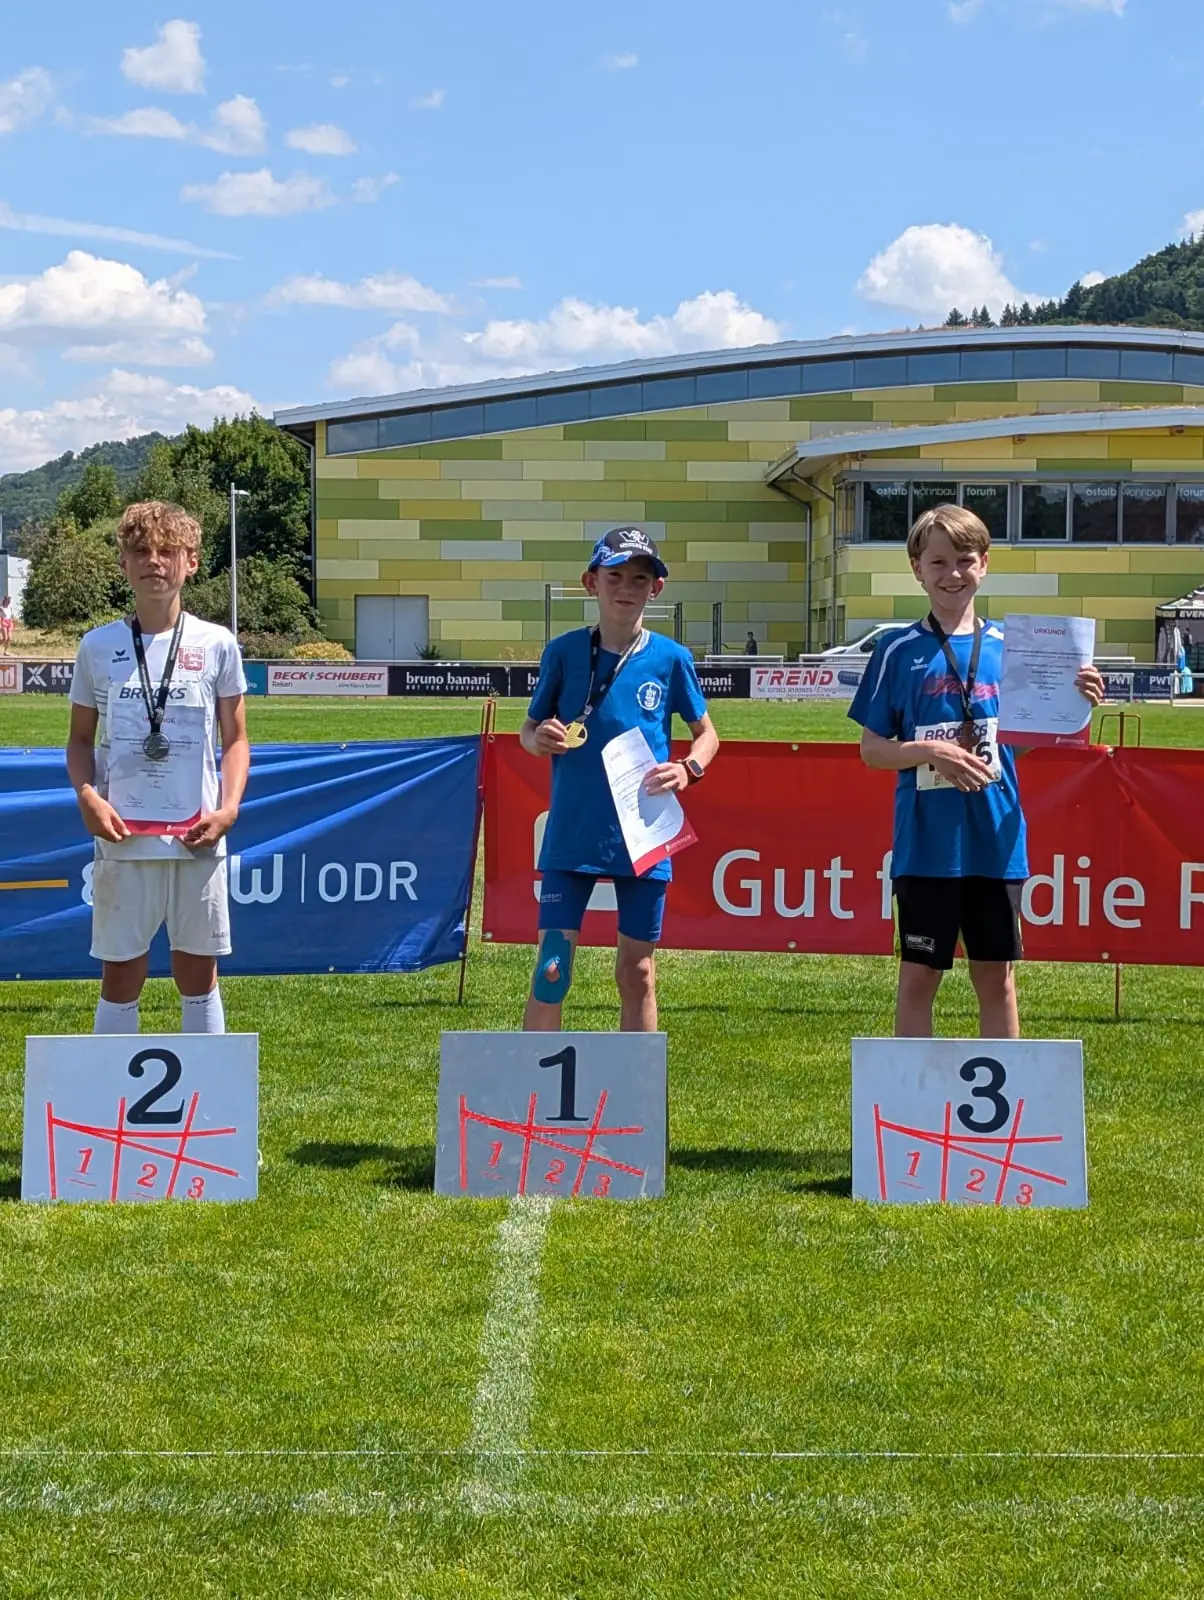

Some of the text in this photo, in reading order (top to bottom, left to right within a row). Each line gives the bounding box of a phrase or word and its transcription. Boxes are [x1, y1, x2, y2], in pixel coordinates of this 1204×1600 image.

[966, 486, 997, 496] forum
[406, 671, 491, 685] bruno banani
[698, 673, 732, 686] anani
[755, 670, 834, 686] TREND
[318, 860, 419, 903] ODR
[712, 848, 855, 920] Gut
[1020, 854, 1145, 929] die
[126, 1047, 185, 1125] 2
[538, 1045, 590, 1122] 1
[957, 1056, 1010, 1134] 3
[77, 1147, 205, 1199] 1 2 3
[488, 1140, 612, 1197] 1 2 3
[906, 1151, 1034, 1206] 1 2 3
